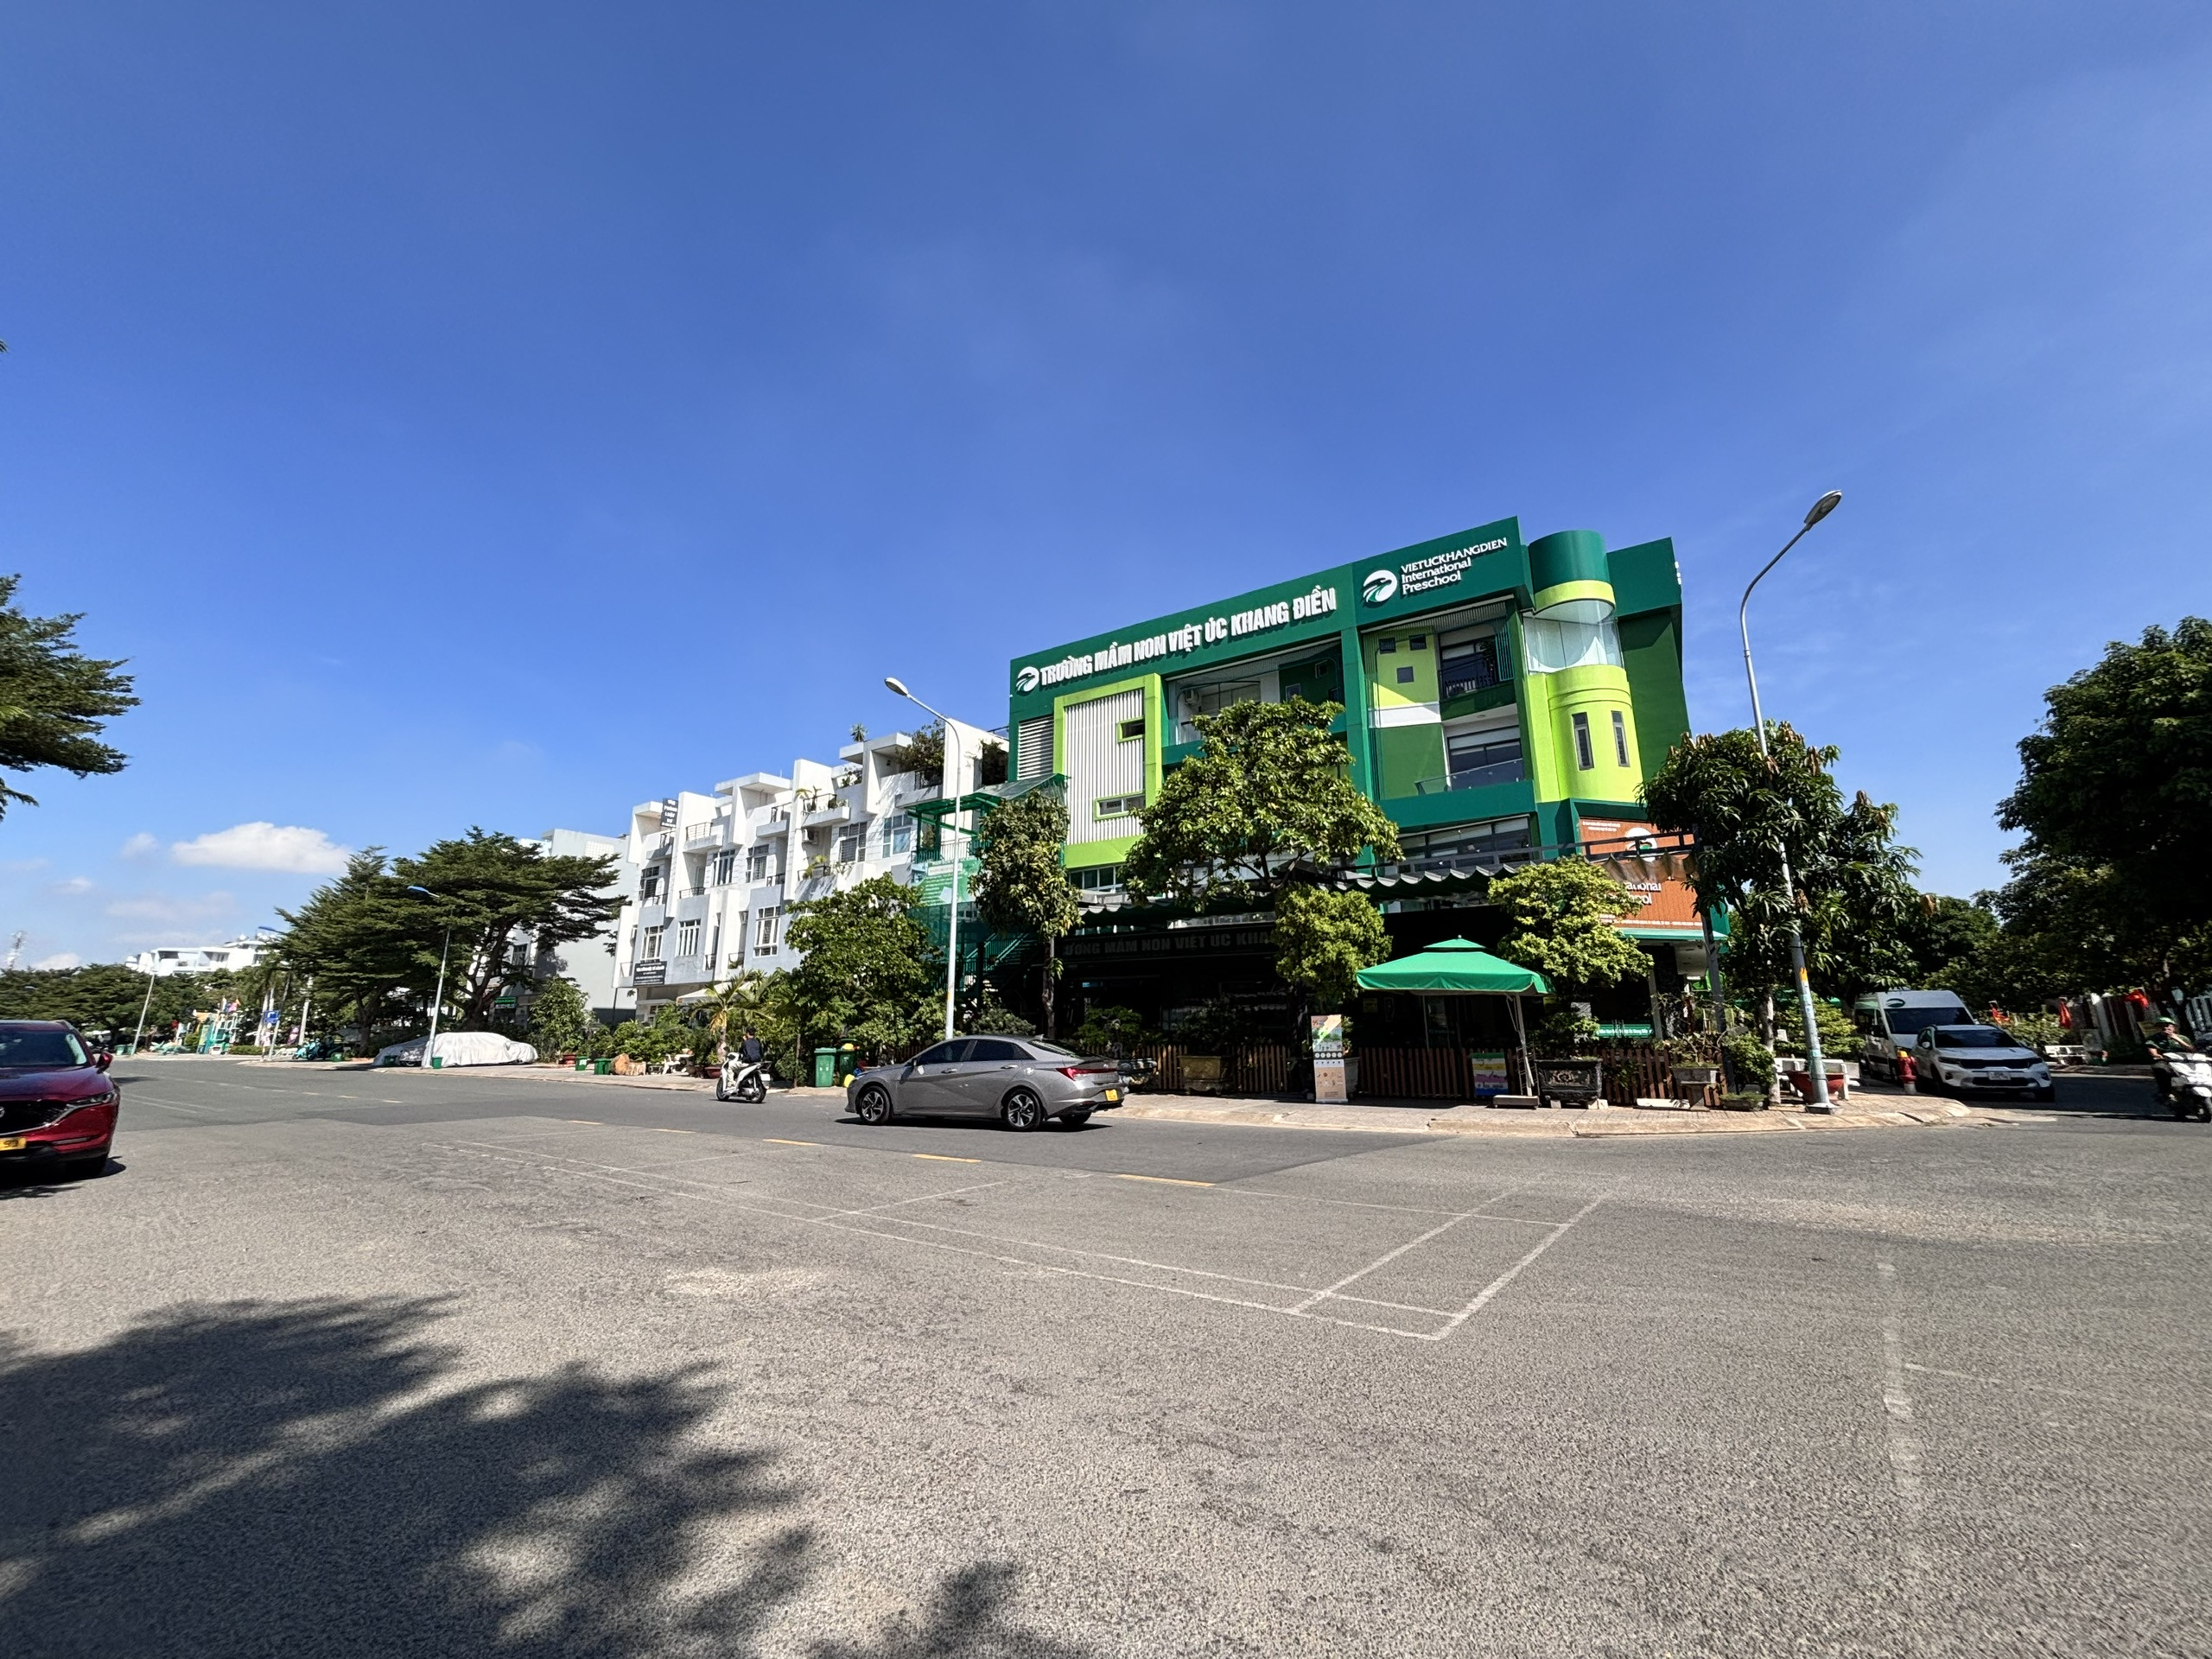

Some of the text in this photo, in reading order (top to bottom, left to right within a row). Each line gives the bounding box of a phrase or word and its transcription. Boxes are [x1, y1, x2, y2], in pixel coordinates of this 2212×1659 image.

[1401, 537, 1508, 574] VIETUCKHANGDIEN
[1402, 556, 1471, 584] International
[1402, 570, 1462, 595] Preschool
[1039, 584, 1337, 686] TRƯỜNG MẦM NON VIỆT ÚC KHANG ĐIỀN
[1141, 938, 1172, 951] NON
